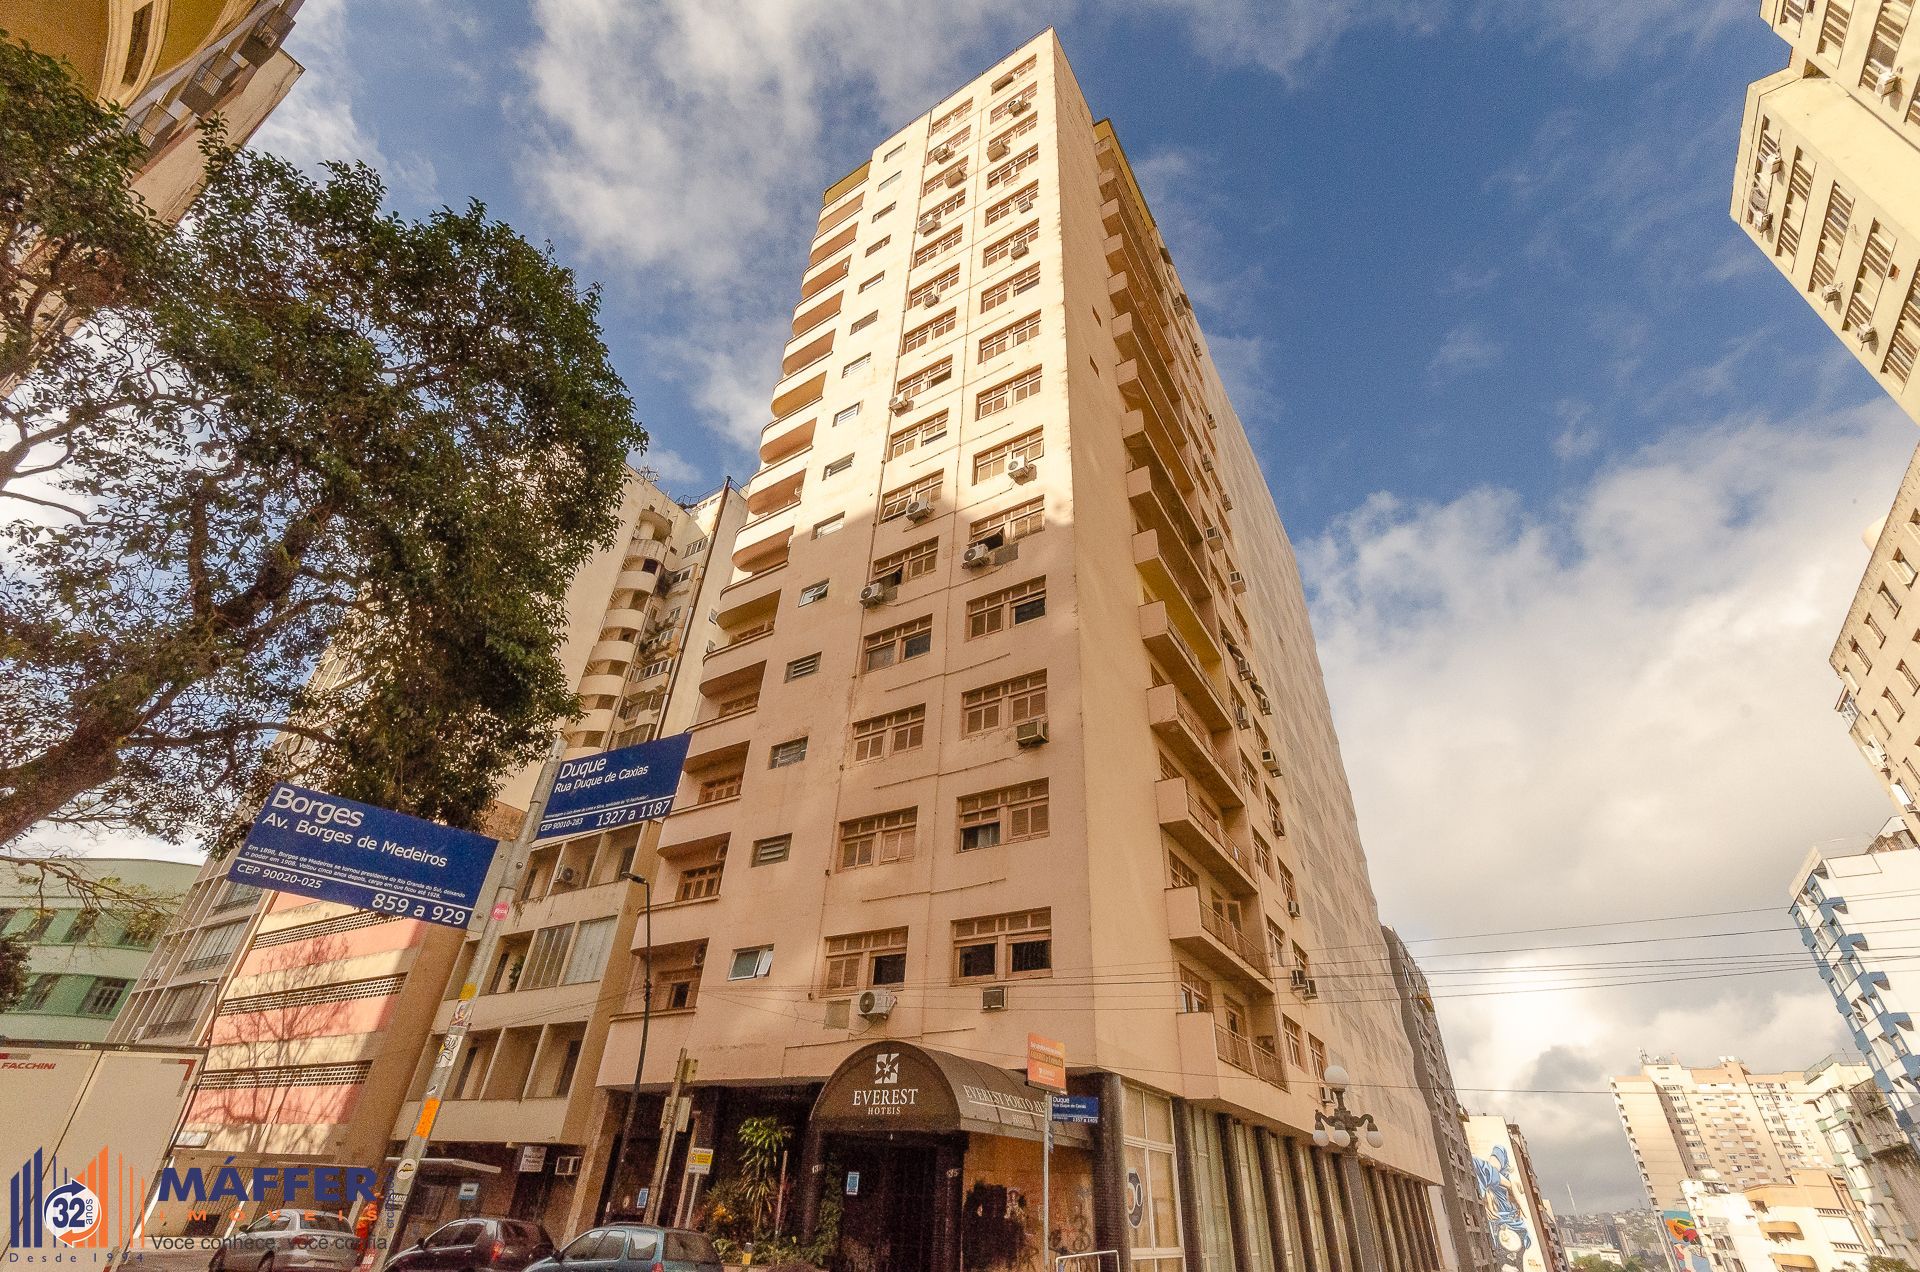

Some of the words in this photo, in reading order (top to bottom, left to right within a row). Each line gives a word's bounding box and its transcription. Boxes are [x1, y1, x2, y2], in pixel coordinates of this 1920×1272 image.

[554, 783, 572, 793] Rua
[574, 776, 602, 790] Duque
[604, 772, 616, 782] de
[618, 765, 649, 780] Caxias
[560, 758, 606, 779] Duque
[271, 786, 365, 827] Borges
[596, 810, 626, 826] 1327
[628, 810, 636, 820] a
[640, 800, 670, 818] 1187
[262, 812, 288, 829] Av.
[296, 820, 354, 844] Borges
[358, 836, 377, 850] de
[382, 841, 448, 868] Medeiros
[540, 824, 552, 832] CEP
[248, 844, 258, 852] Em
[237, 863, 260, 875] CEP
[262, 869, 322, 888] 90020-025
[372, 893, 410, 913] 859
[414, 905, 425, 918] a
[431, 906, 466, 925] 929
[1, 1062, 56, 1070] FACCHINI
[852, 1088, 918, 1106] EVEREST
[962, 1084, 1004, 1106] EVEREST
[1003, 1093, 1034, 1111] PORTO
[868, 1106, 900, 1115] HOTEIS
